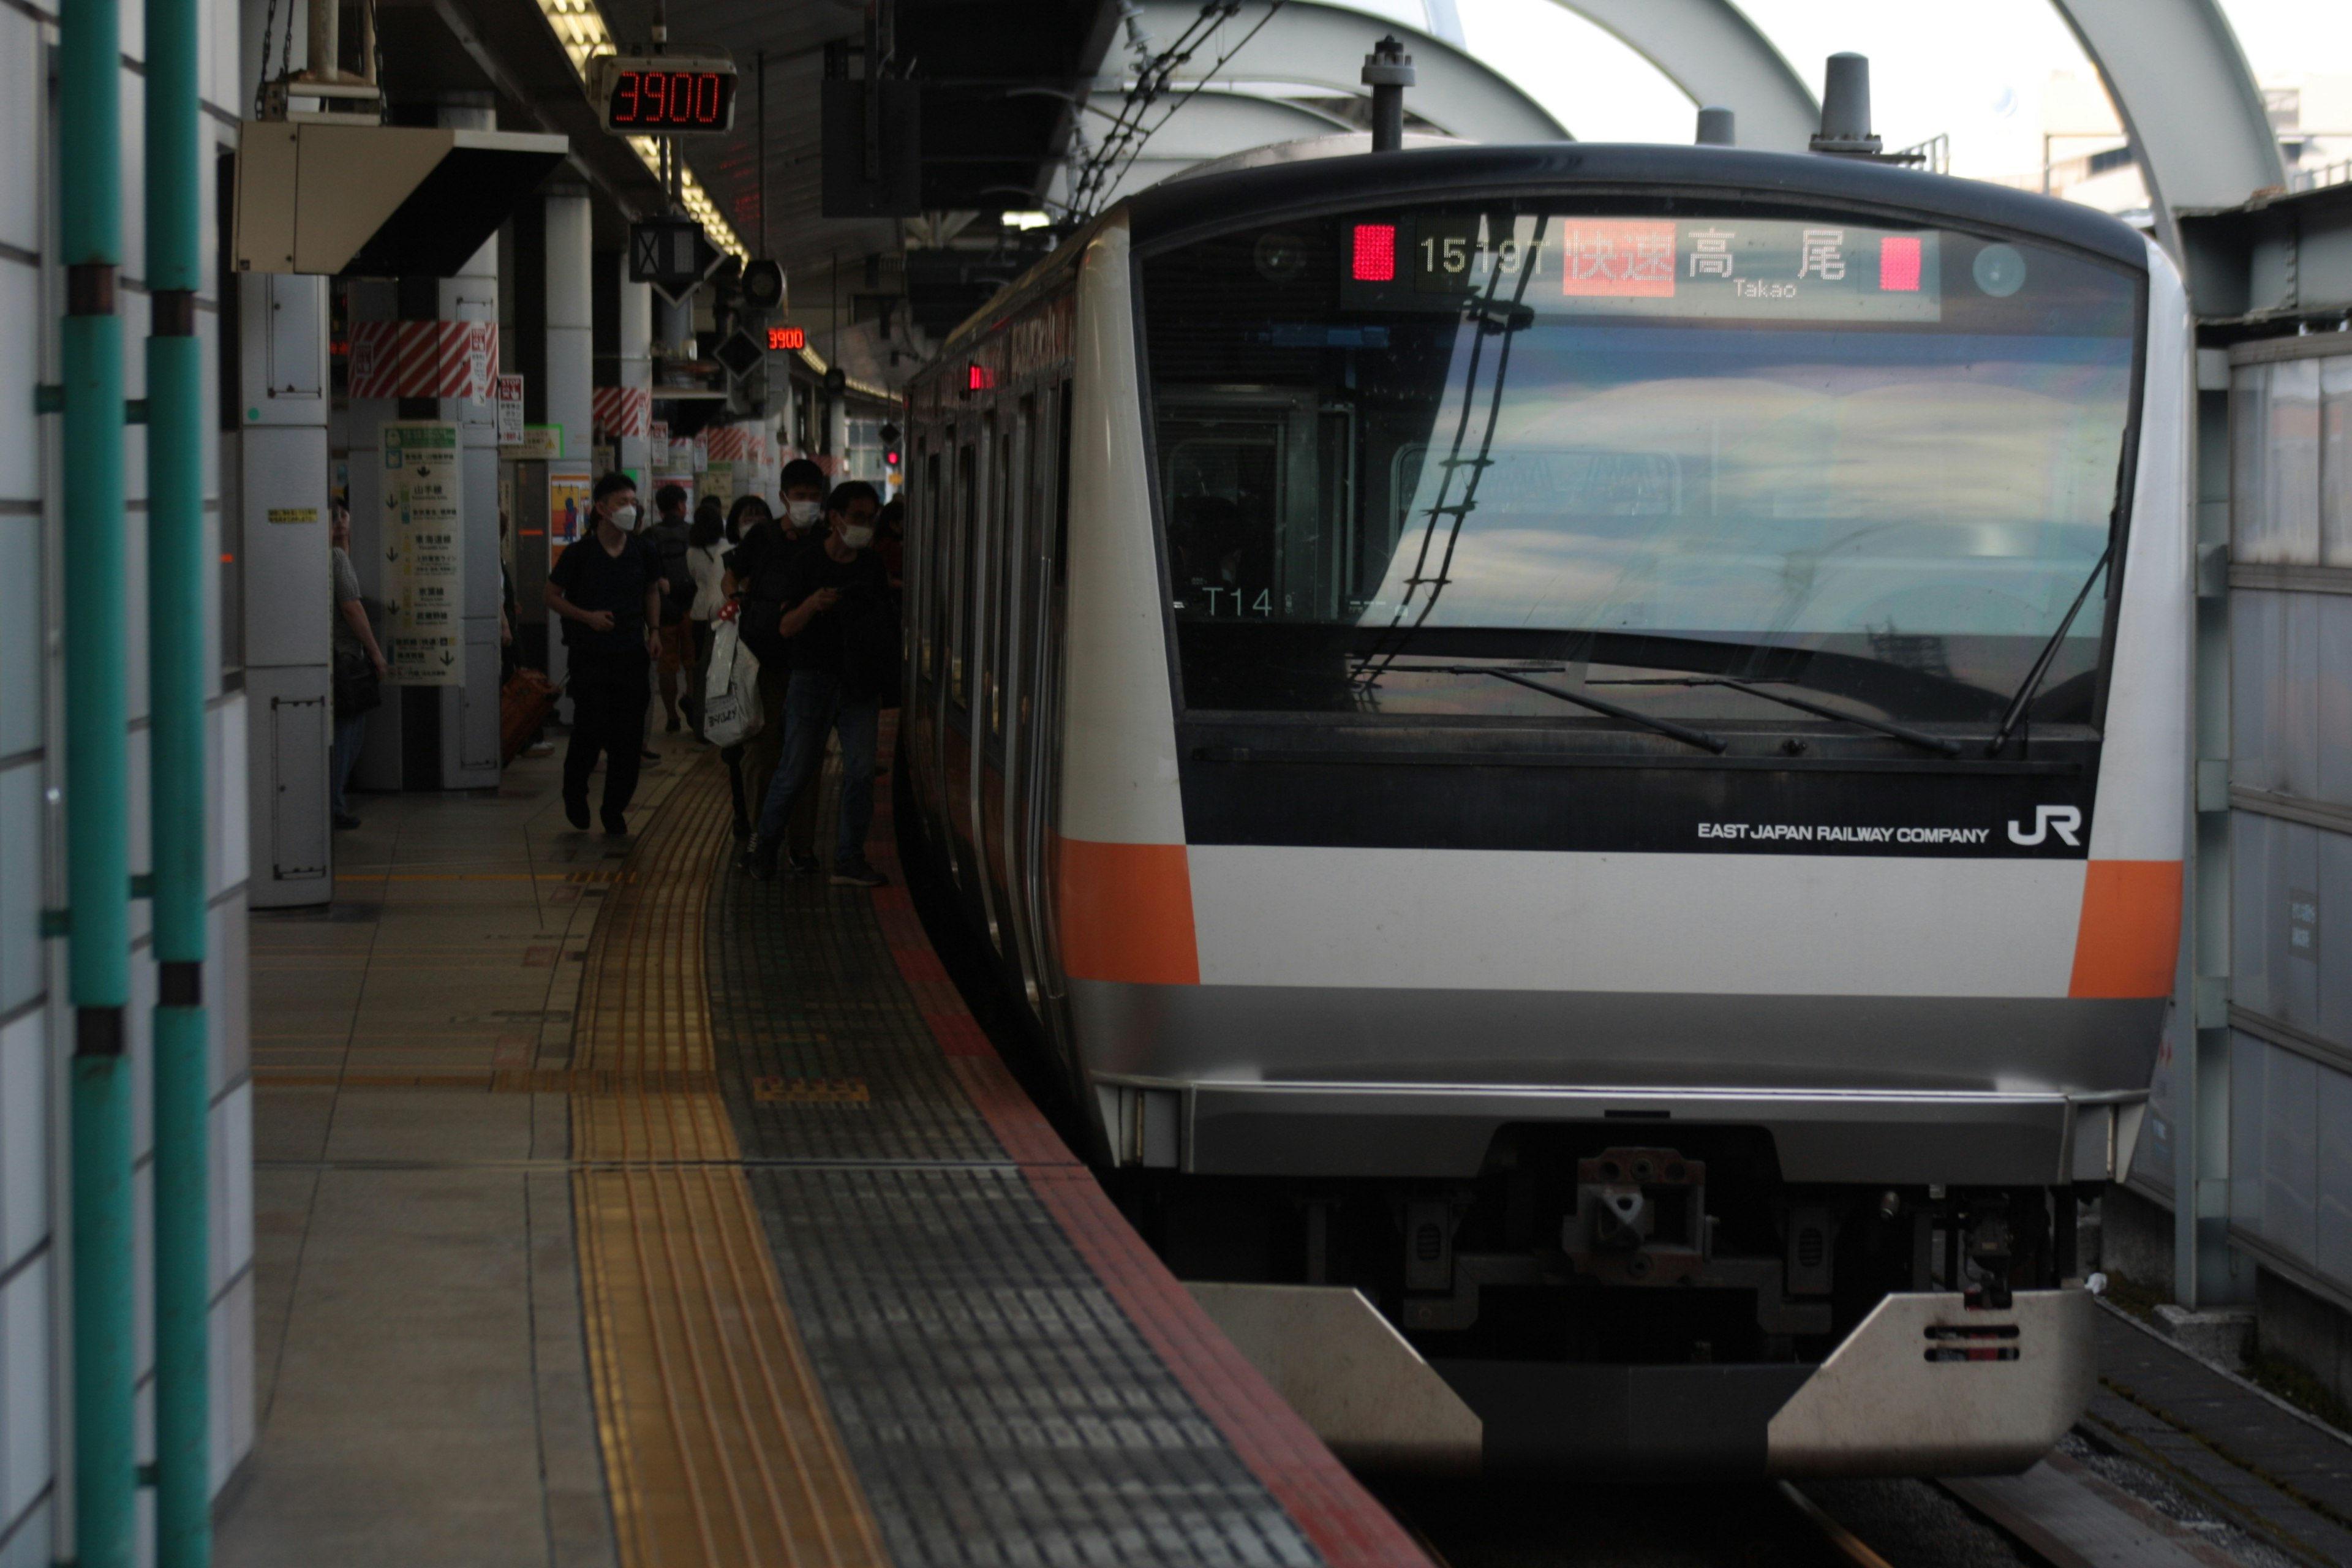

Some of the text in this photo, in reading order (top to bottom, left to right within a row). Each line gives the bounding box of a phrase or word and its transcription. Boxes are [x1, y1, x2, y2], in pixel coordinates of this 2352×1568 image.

[616, 71, 719, 123] 3900
[1420, 236, 1551, 274] 1519T
[1566, 229, 1673, 281] 快速
[1688, 227, 1845, 281] 高尾
[1733, 279, 1796, 298] Takao
[768, 328, 803, 349] 3900
[1202, 587, 1273, 617] T14
[1698, 823, 1990, 843] EAST JAPAN RAILWAY COMPANY
[2007, 804, 2082, 846] JR
